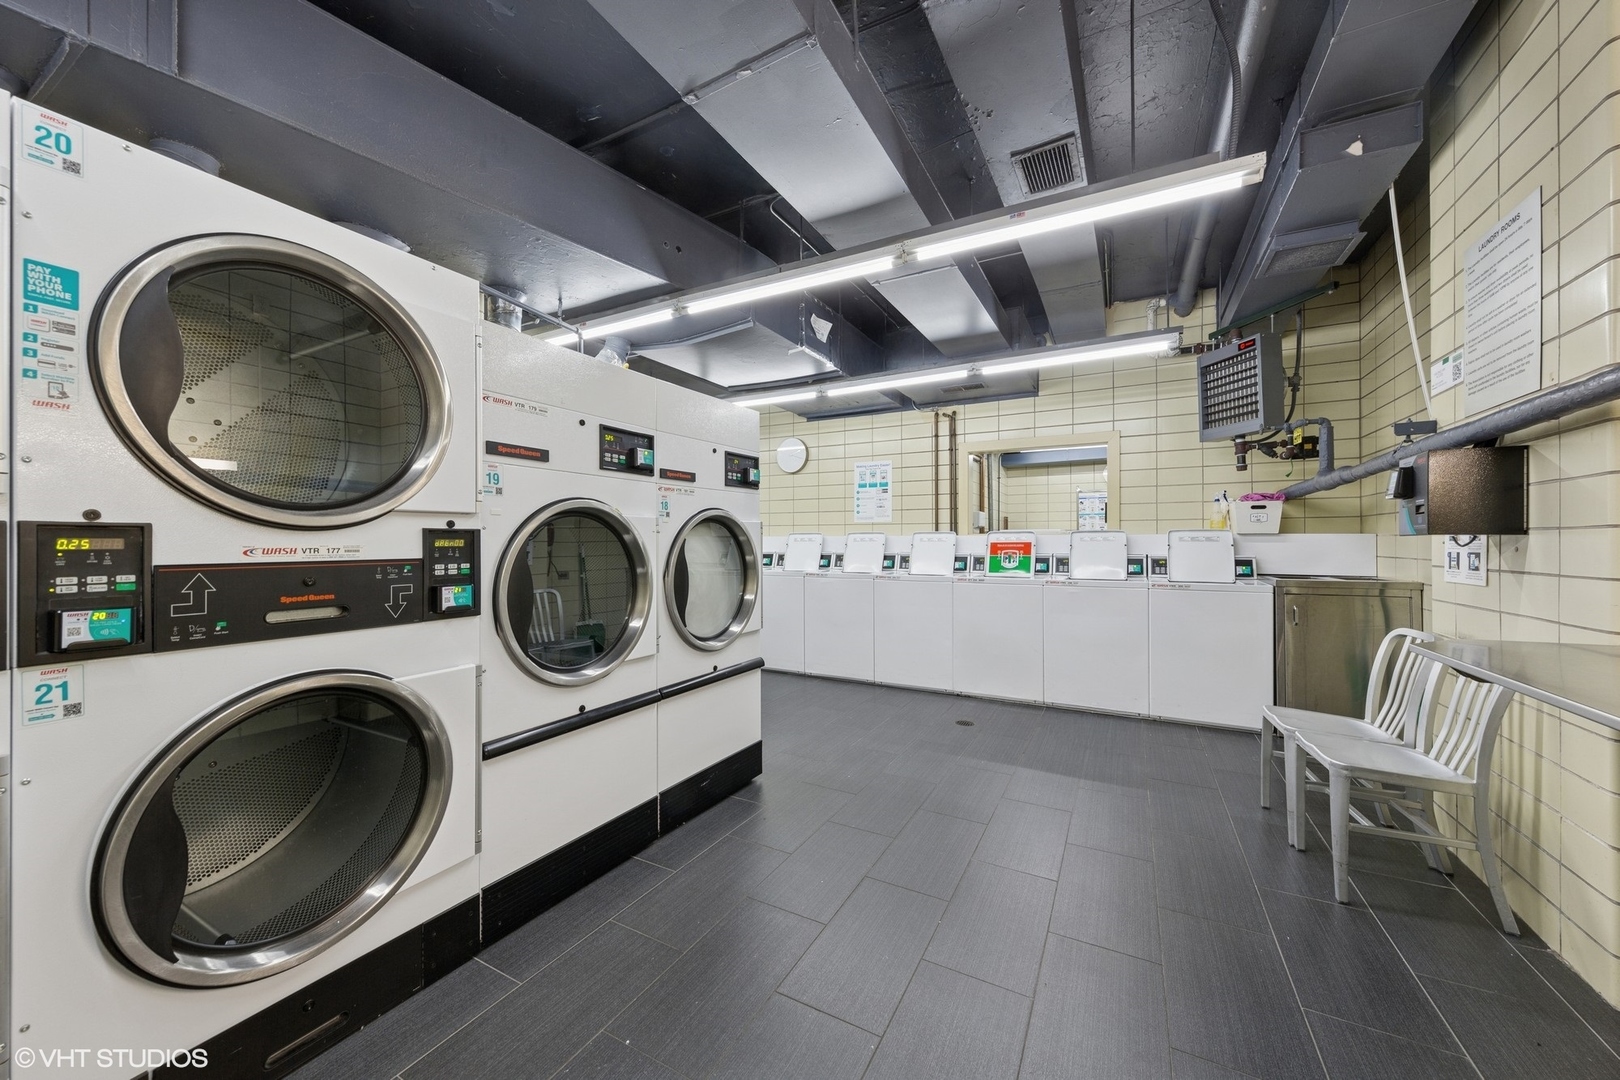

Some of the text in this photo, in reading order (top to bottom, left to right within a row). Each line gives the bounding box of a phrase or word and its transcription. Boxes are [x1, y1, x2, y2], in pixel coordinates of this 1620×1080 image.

[40, 113, 68, 126] WASH
[35, 125, 72, 155] 20
[1478, 212, 1521, 252] LAUNDRY ROOMS
[27, 263, 51, 274] PAY
[27, 270, 61, 284] WITH
[27, 277, 63, 292] YOUR
[27, 284, 72, 300] PHONE
[32, 399, 70, 410] WASH
[492, 397, 513, 406] WASH
[497, 445, 541, 457] Speed Queen
[486, 472, 500, 485] 19
[661, 501, 669, 511] 18
[56, 539, 89, 550] 0.25
[261, 547, 298, 555] WASH
[280, 595, 308, 604] Speed
[92, 612, 106, 620] 20
[40, 668, 69, 676] WASH
[35, 681, 68, 705] 21
